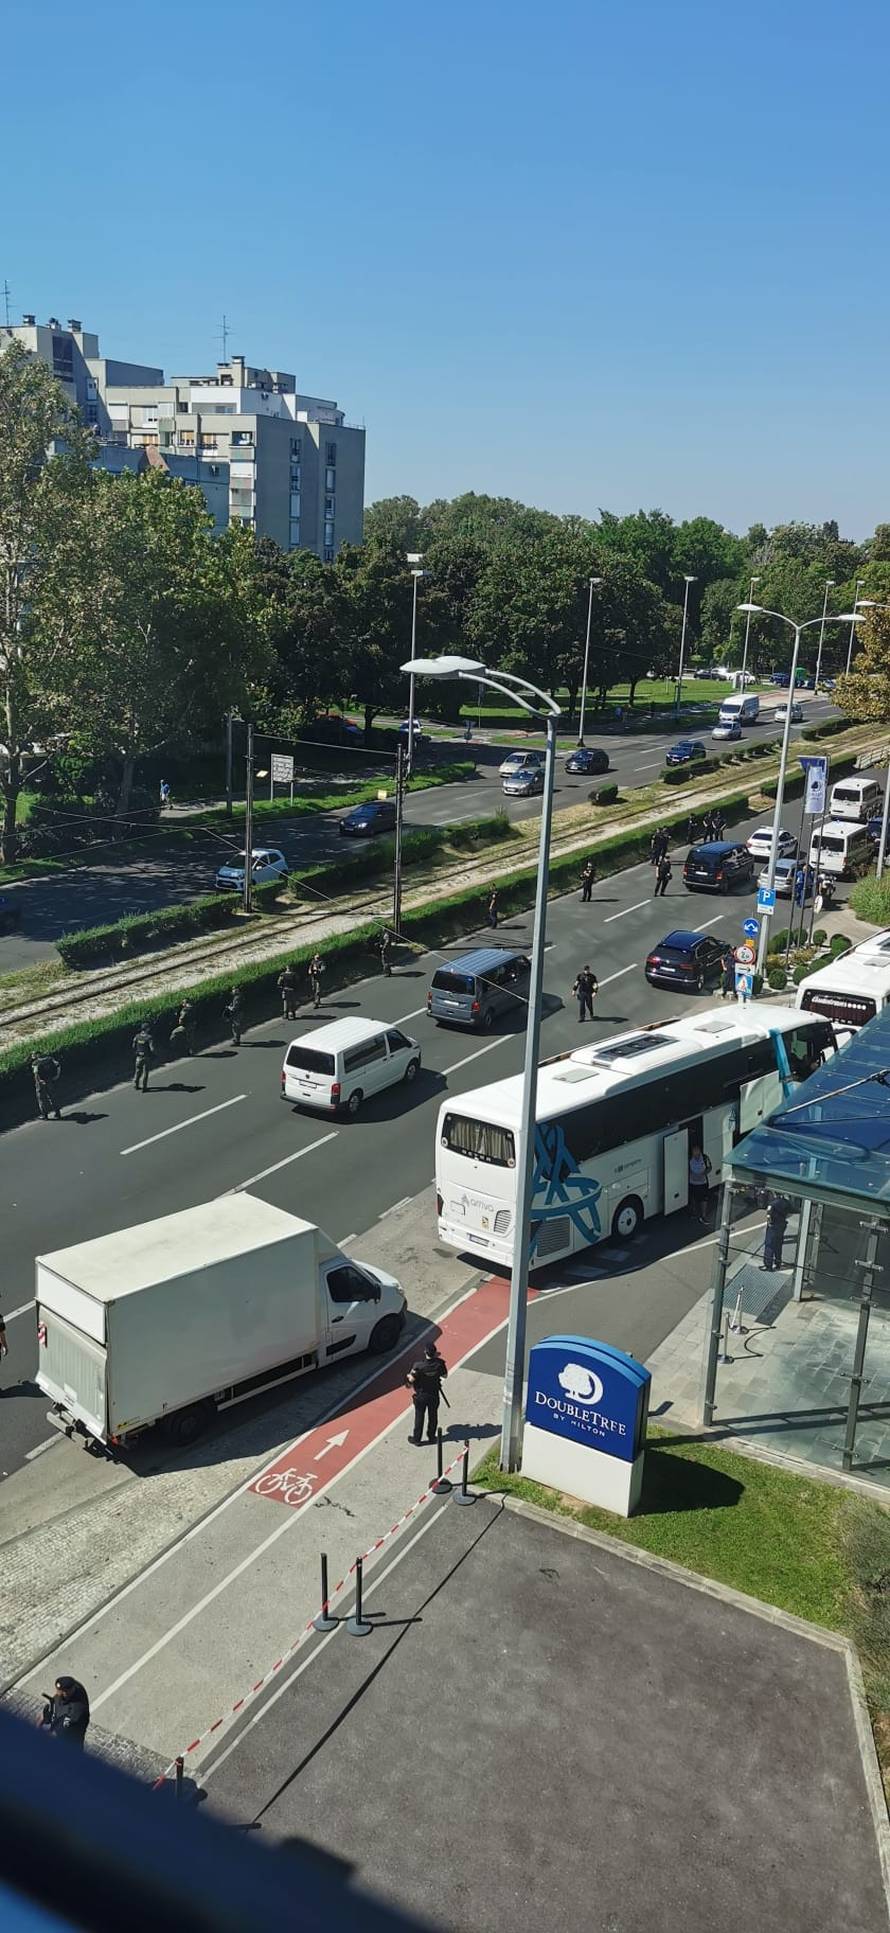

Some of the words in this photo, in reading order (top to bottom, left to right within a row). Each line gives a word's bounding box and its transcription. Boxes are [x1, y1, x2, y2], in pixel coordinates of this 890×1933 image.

[763, 891, 771, 902] P
[535, 1391, 627, 1436] DOUBLETREE
[553, 1412, 565, 1421] BY
[570, 1420, 606, 1437] HILTON
